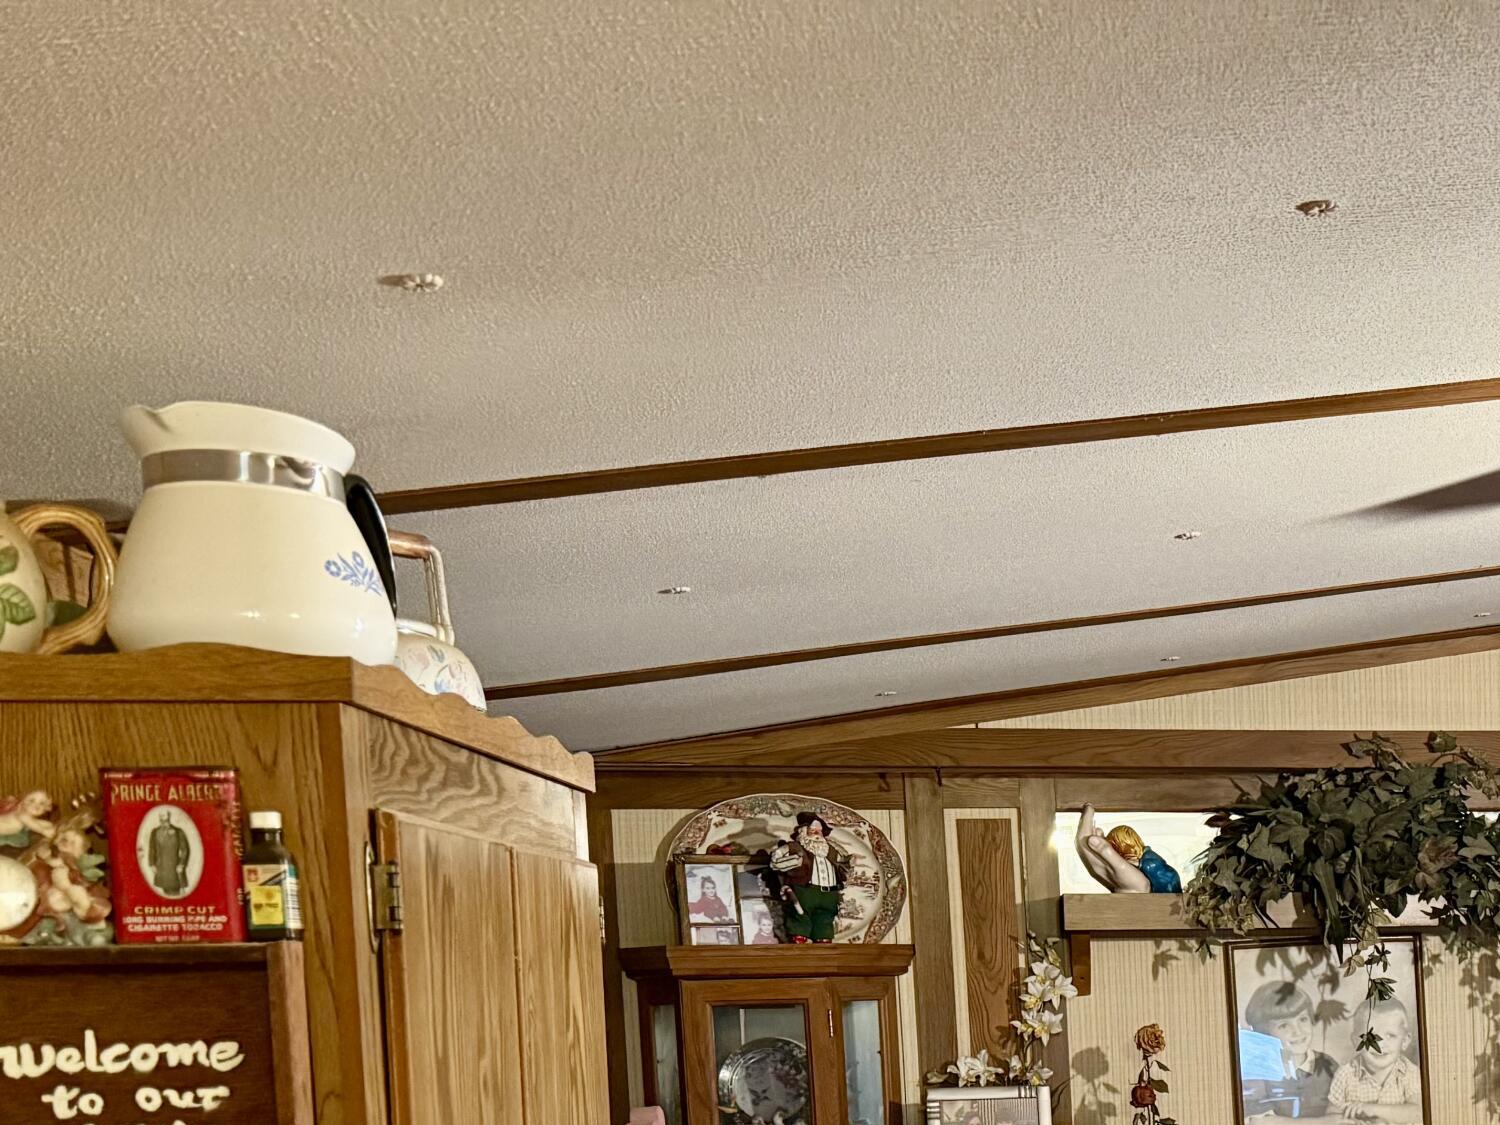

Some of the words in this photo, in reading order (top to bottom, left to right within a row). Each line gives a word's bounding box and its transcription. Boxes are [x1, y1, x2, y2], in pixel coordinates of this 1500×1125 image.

[111, 783, 161, 805] PRINCE
[134, 905, 184, 915] CRIMP
[187, 905, 216, 914] CUT
[208, 915, 228, 923] AND
[128, 924, 180, 932] CIGARETTE
[182, 923, 224, 932] TOBACCO
[0, 1029, 245, 1079] welcome
[41, 1085, 104, 1119] to
[135, 1086, 230, 1112] our
